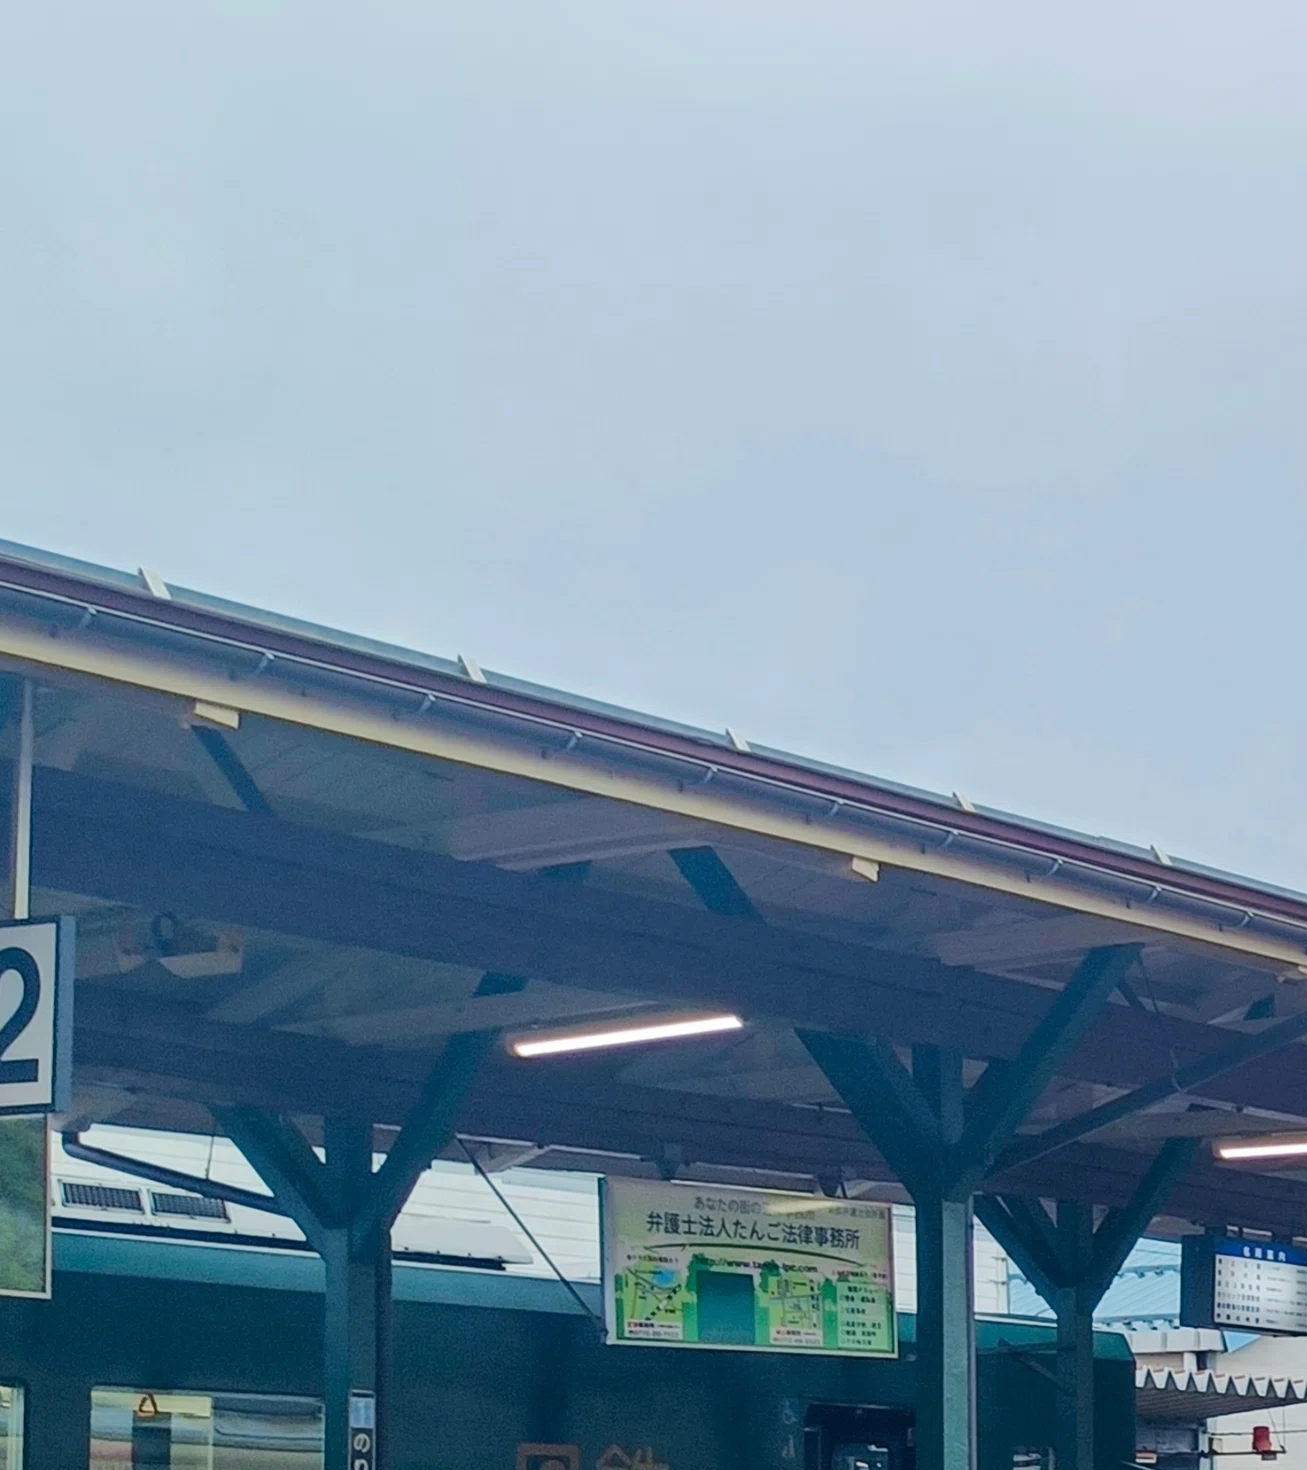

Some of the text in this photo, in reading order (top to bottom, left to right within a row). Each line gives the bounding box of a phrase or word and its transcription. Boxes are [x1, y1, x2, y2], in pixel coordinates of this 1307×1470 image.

[0, 946, 41, 1083] 2
[646, 1211, 860, 1248] 弁護士法人たんご法律事務所
